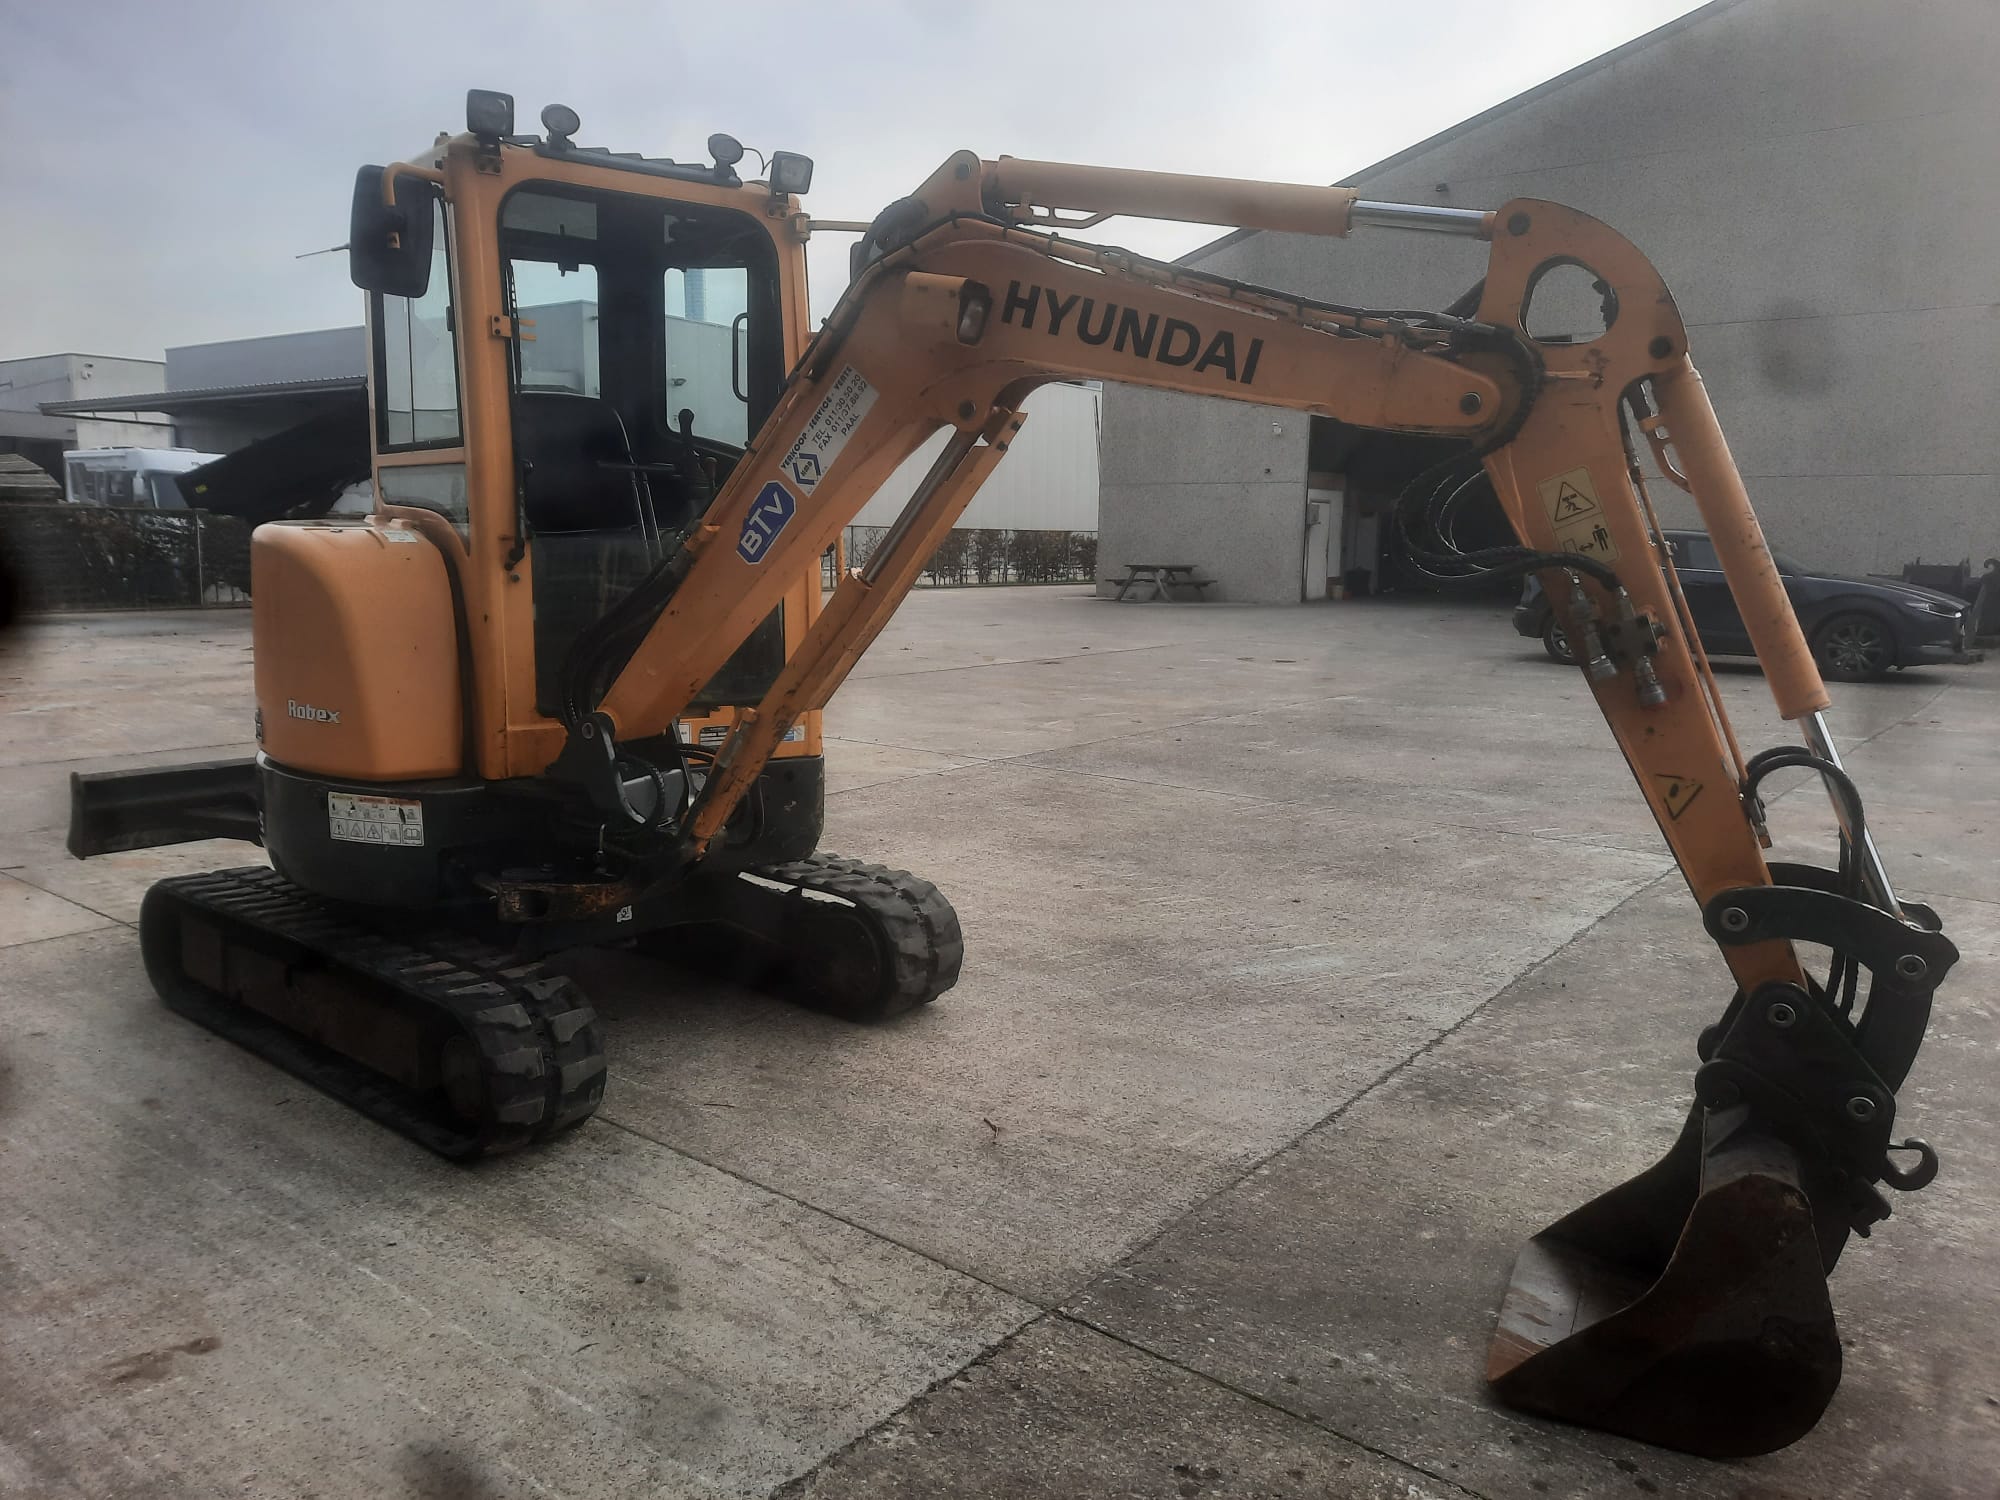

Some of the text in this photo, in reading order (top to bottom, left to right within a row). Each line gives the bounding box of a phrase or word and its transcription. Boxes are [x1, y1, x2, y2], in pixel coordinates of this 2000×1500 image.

[1001, 280, 1264, 384] HYUNDAI
[780, 432, 807, 469] VERKOOP
[808, 396, 833, 429] SERVICE
[818, 433, 832, 451] FAX
[841, 414, 860, 435] PAAL
[740, 491, 783, 556] BTV
[288, 699, 341, 724] Robex
